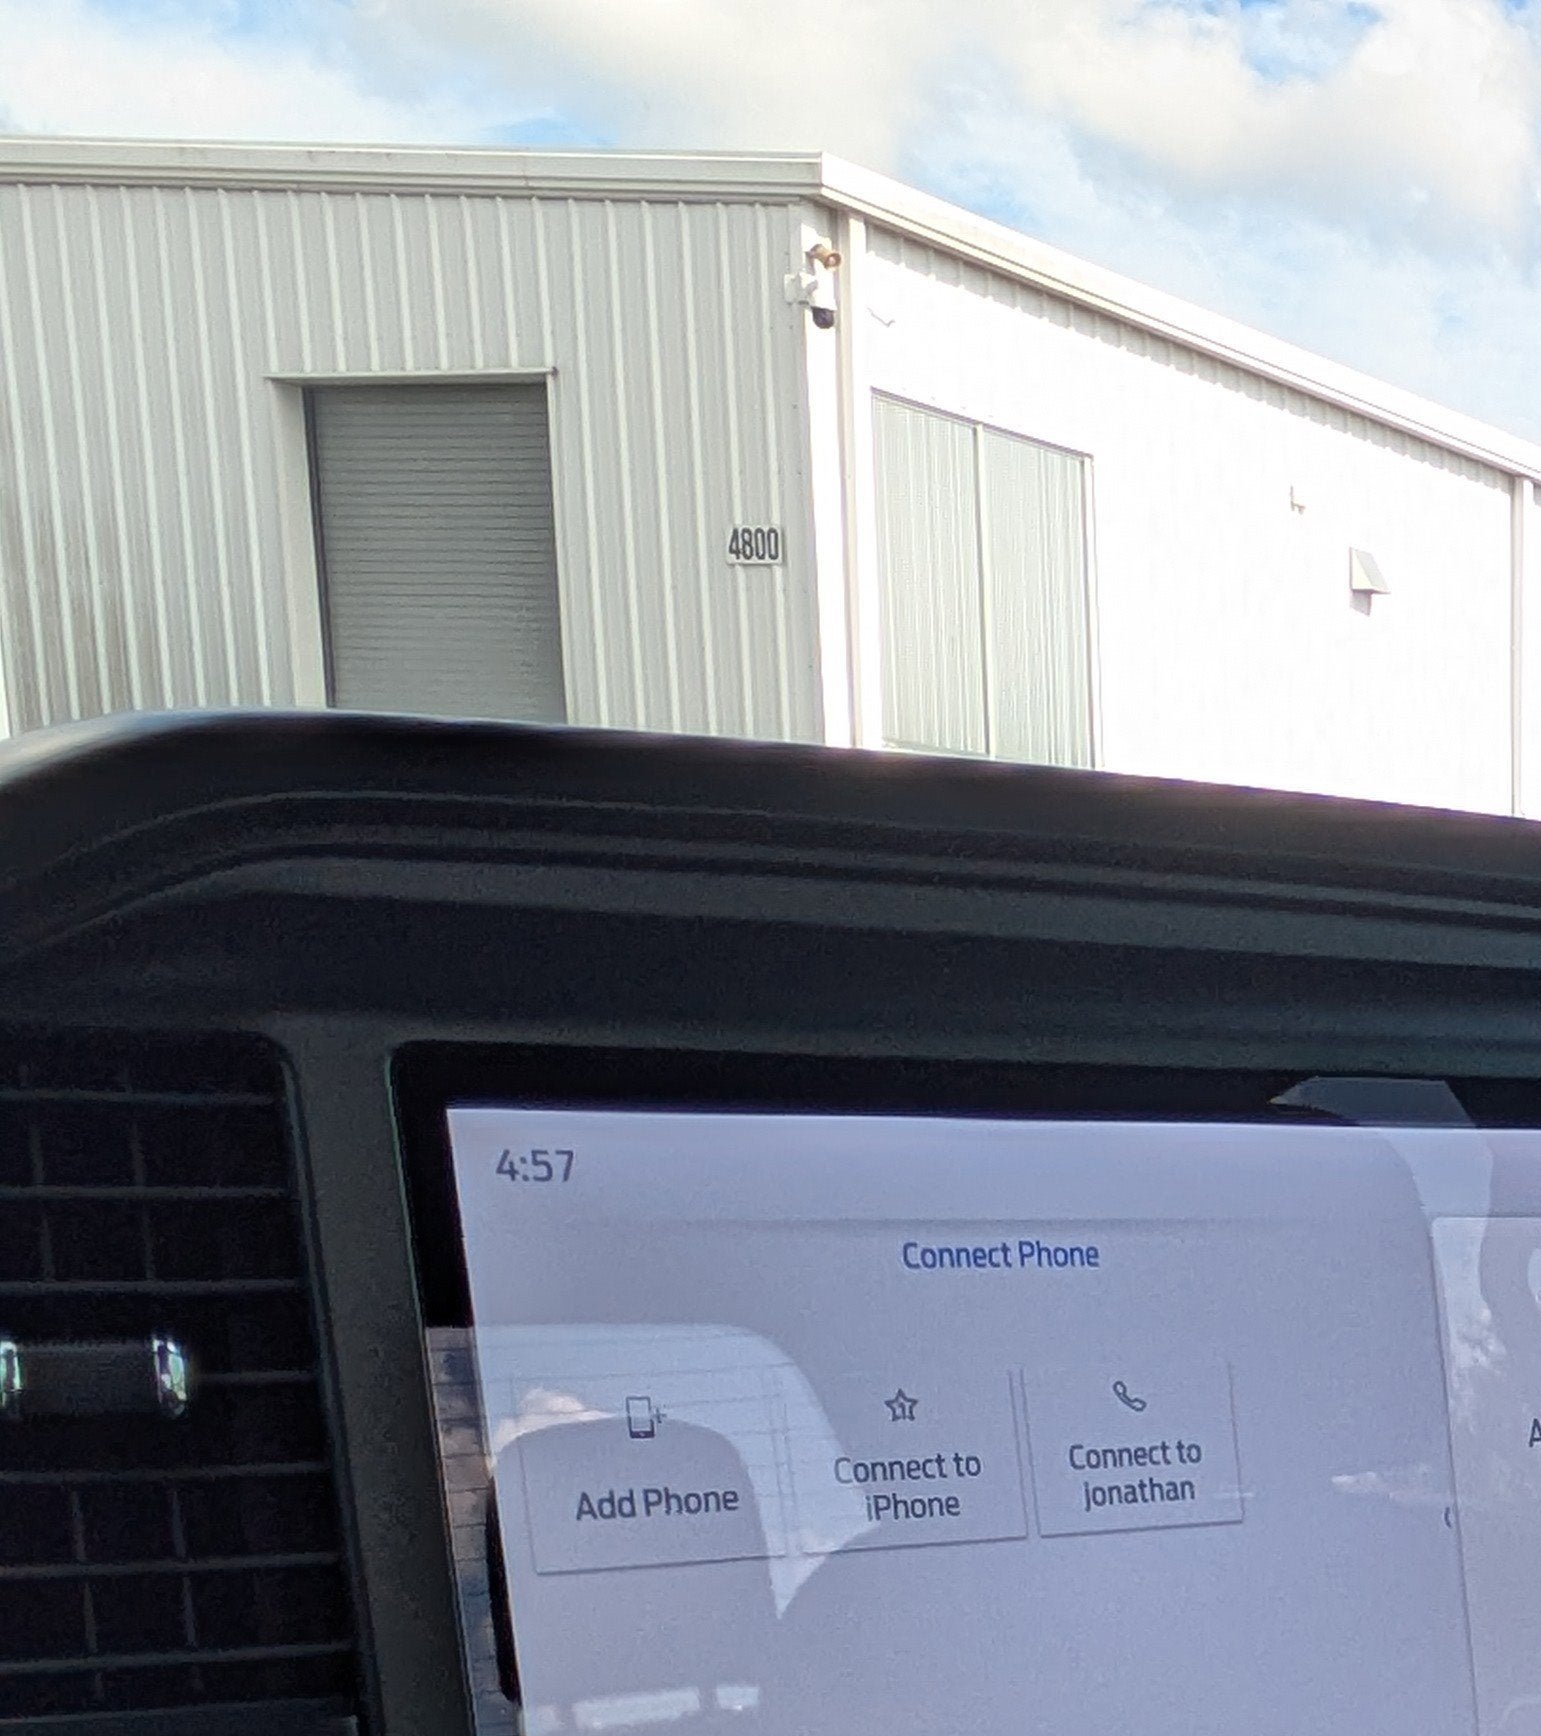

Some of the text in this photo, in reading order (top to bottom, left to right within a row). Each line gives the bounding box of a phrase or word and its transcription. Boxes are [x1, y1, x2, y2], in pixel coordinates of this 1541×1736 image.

[728, 527, 779, 560] 4800
[496, 1149, 574, 1182] 4:57
[902, 1239, 1100, 1269] Connect Phone
[833, 1452, 982, 1485] Connect to
[1069, 1439, 1202, 1470] Connect to
[576, 1486, 739, 1521] Add Phone
[866, 1493, 961, 1522] iPhone
